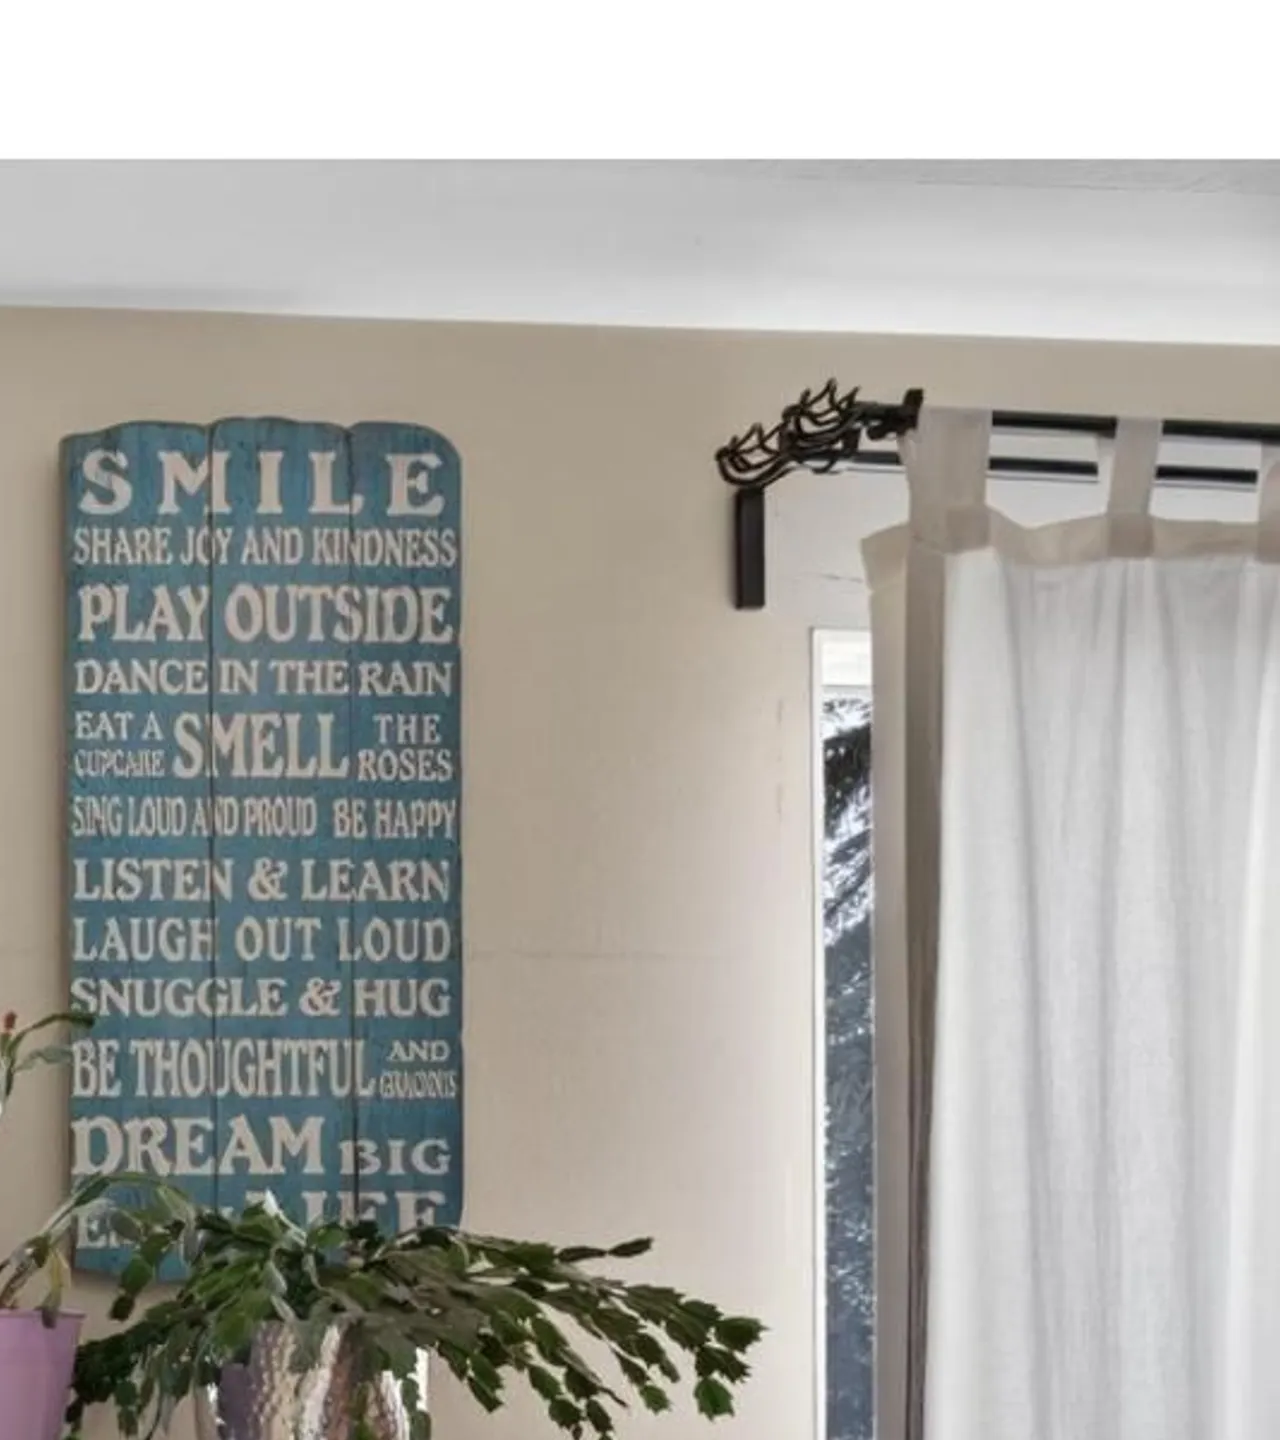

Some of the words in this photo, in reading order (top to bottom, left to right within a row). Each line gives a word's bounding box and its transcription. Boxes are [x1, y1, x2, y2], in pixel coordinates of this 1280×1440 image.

[78, 450, 445, 517] SMILE
[73, 528, 172, 565] SHARE
[180, 527, 233, 566] JOY
[241, 529, 303, 566] AND
[312, 529, 457, 567] KINDNESS
[78, 585, 211, 642] PLAY
[225, 583, 453, 644] OUTSIDE
[75, 659, 207, 695] DANCE
[219, 659, 258, 695] IN
[270, 660, 348, 695] THE
[358, 661, 452, 697] RAIN
[75, 711, 134, 740] EAT
[142, 711, 165, 740] A
[173, 712, 347, 778] SMELL
[373, 714, 441, 744] THE
[358, 749, 453, 781] ROSES
[71, 796, 122, 836] SING
[128, 796, 186, 837] LOUD
[192, 796, 238, 837] AND
[244, 797, 317, 837] PROUD
[333, 797, 367, 838] BE
[374, 799, 456, 839] HAPPY
[73, 857, 234, 901] LISTEN
[248, 856, 288, 900] &
[301, 859, 450, 902] LEARN
[72, 916, 220, 961] LAUGH
[235, 917, 322, 962] OUT
[338, 917, 452, 963] LOUD
[71, 977, 288, 1018] SNUGGLE
[299, 977, 341, 1017] &
[354, 978, 451, 1018] HUG
[71, 1040, 123, 1098] BE
[129, 1037, 377, 1099] THOUGHTFUL
[385, 1039, 451, 1061] AND
[71, 1115, 326, 1177] DREAM
[340, 1138, 451, 1176] BIG
